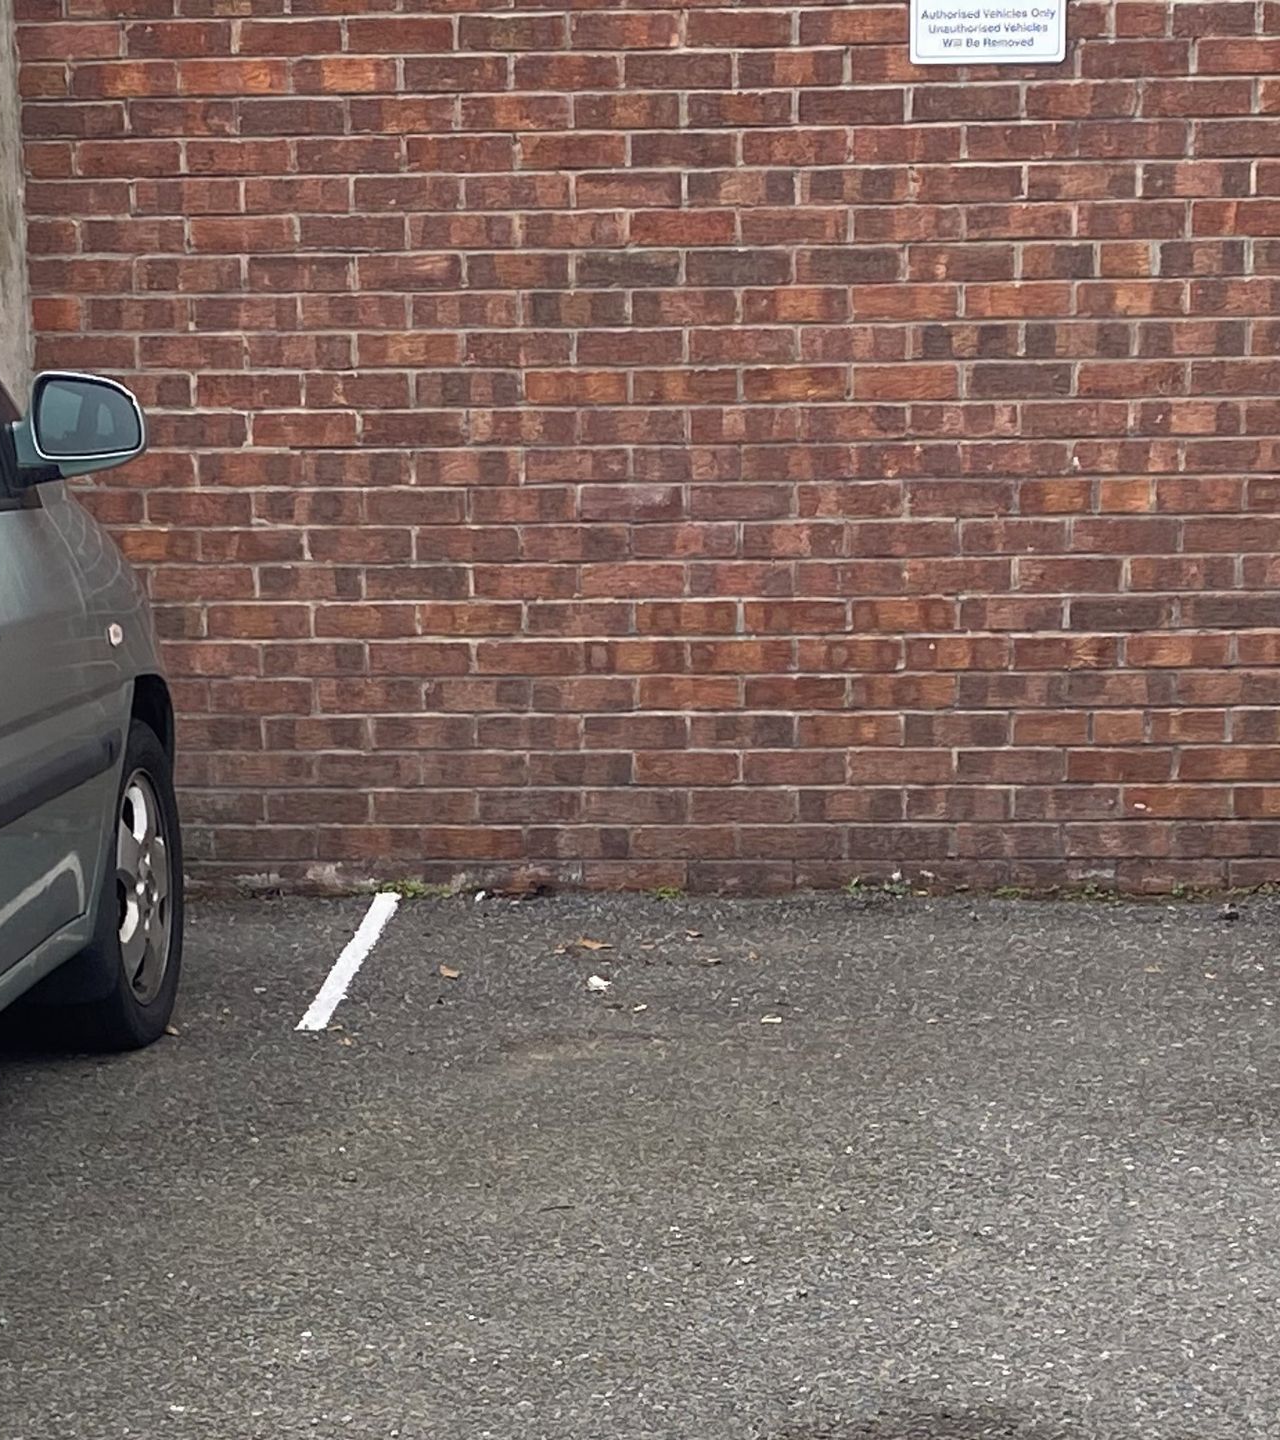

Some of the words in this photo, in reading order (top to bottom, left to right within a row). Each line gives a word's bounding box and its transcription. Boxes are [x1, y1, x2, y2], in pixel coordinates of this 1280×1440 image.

[921, 9, 980, 20] Authorised
[984, 9, 1028, 18] Vehicles
[1031, 8, 1056, 20] Only
[928, 24, 1001, 34] Unauthorised
[1005, 22, 1049, 33] Vehicles
[966, 37, 980, 47] Be
[983, 37, 1034, 47] Removed
